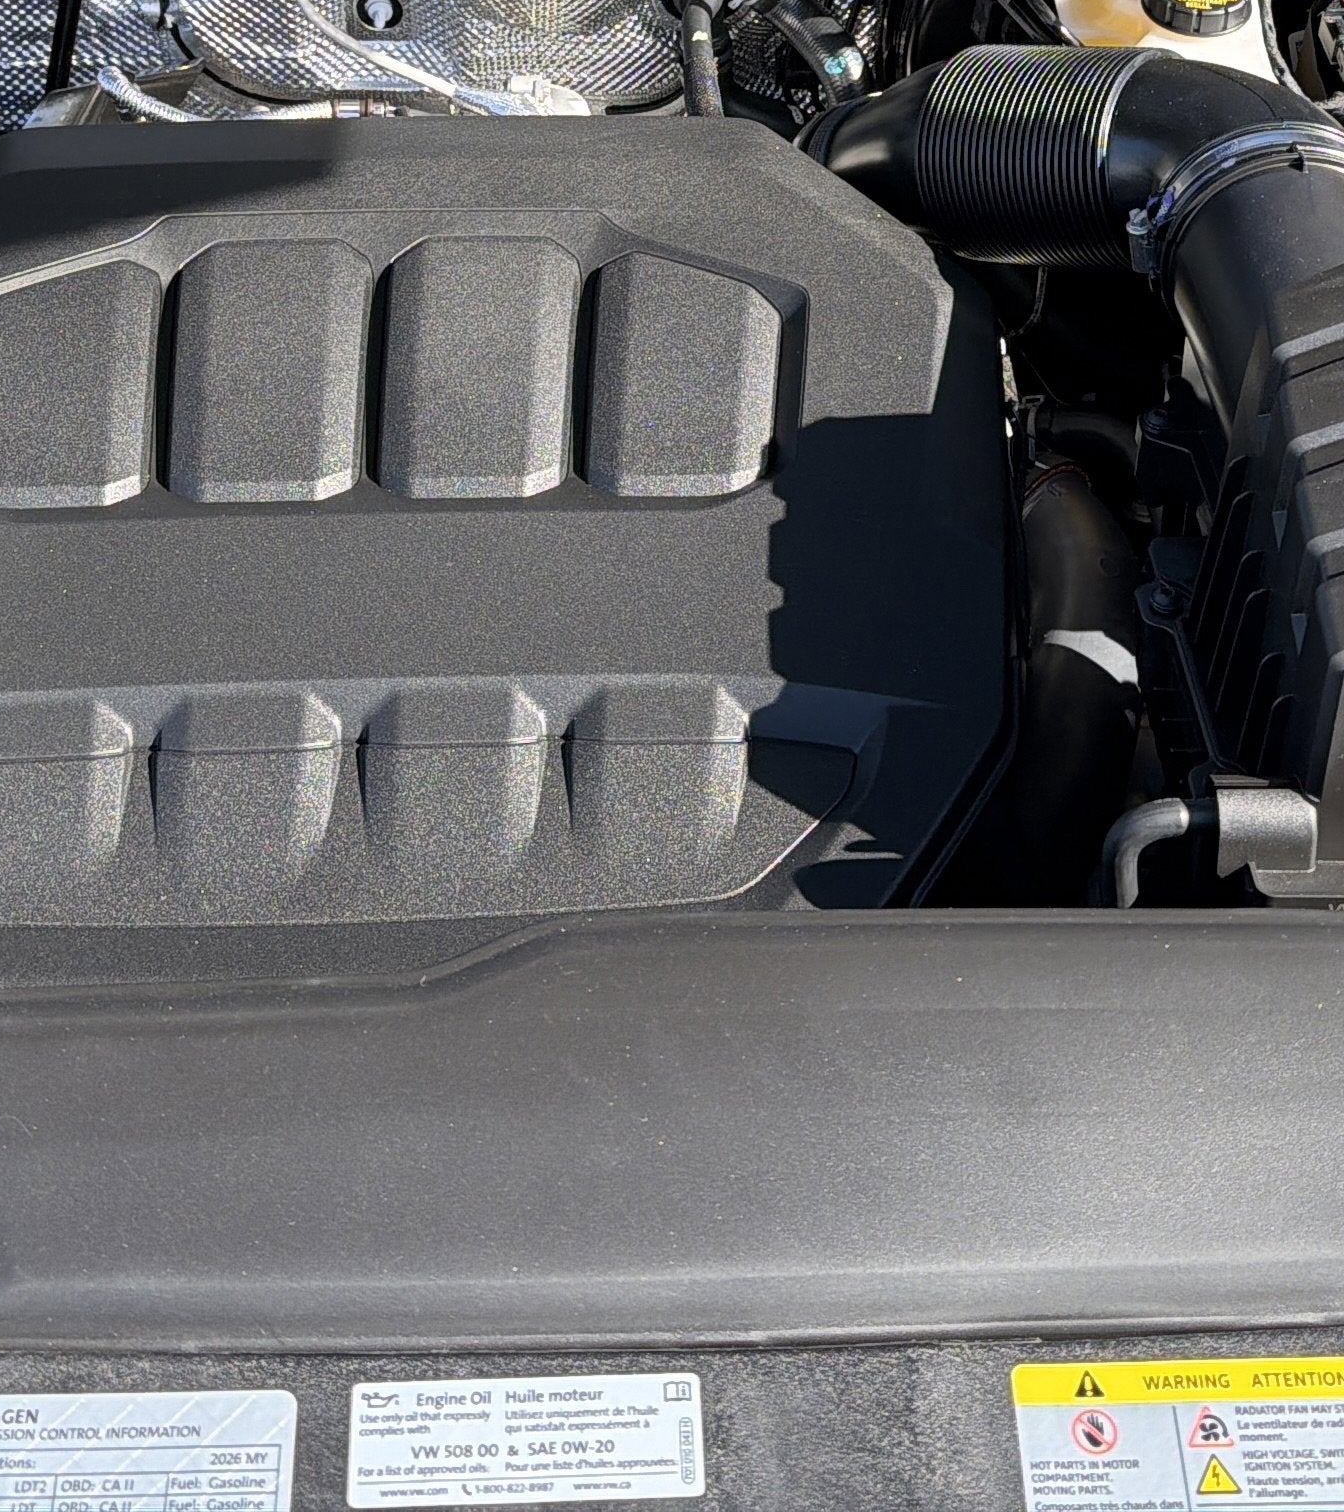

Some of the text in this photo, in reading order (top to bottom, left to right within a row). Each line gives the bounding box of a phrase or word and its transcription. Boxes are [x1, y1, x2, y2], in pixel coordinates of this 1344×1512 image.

[1143, 1373, 1231, 1391] WARNING
[416, 1390, 492, 1410] Engine Oil
[505, 1389, 604, 1403] Huile moteur
[505, 1409, 544, 1420] Utilisez
[546, 1408, 610, 1420] uniquement
[612, 1407, 626, 1417] de
[1234, 1404, 1286, 1415] RADIATOR
[1288, 1404, 1308, 1414] FAN
[1311, 1404, 1332, 1413] MAY
[359, 1411, 491, 1425] Use only oil that expressly
[1237, 1420, 1249, 1430] Le
[1252, 1419, 1308, 1430] ventilateur
[1311, 1419, 1324, 1428] de
[39, 1427, 102, 1442] CONTROL
[105, 1425, 202, 1440] INFORMATION
[359, 1425, 431, 1438] complies with
[504, 1418, 651, 1436] qui satisfait expressément à
[411, 1439, 616, 1460] VW 508 00 & SAE 0W-20
[1242, 1449, 1268, 1460] HIGH
[209, 1453, 242, 1466] 2026
[245, 1451, 268, 1465] MY
[1030, 1459, 1140, 1471] HOT PARTS IN MOTOR
[357, 1466, 374, 1477] For
[375, 1468, 384, 1476] a
[385, 1465, 401, 1476] list
[403, 1464, 415, 1475] of
[416, 1463, 467, 1476] approved
[505, 1461, 529, 1472] Pour
[530, 1462, 551, 1472] une
[552, 1459, 574, 1470] liste
[1244, 1461, 1291, 1472] IGNITION
[14, 1480, 47, 1494] LDT2
[102, 1479, 121, 1491] CA
[170, 1477, 202, 1489] Fuel:
[208, 1476, 266, 1488] Gasoline
[1247, 1476, 1279, 1486] Haute
[1032, 1485, 1076, 1496] MOVING
[206, 1498, 265, 1511] Gasoline
[1121, 1500, 1158, 1511] chauds
[1160, 1499, 1184, 1510] dans
